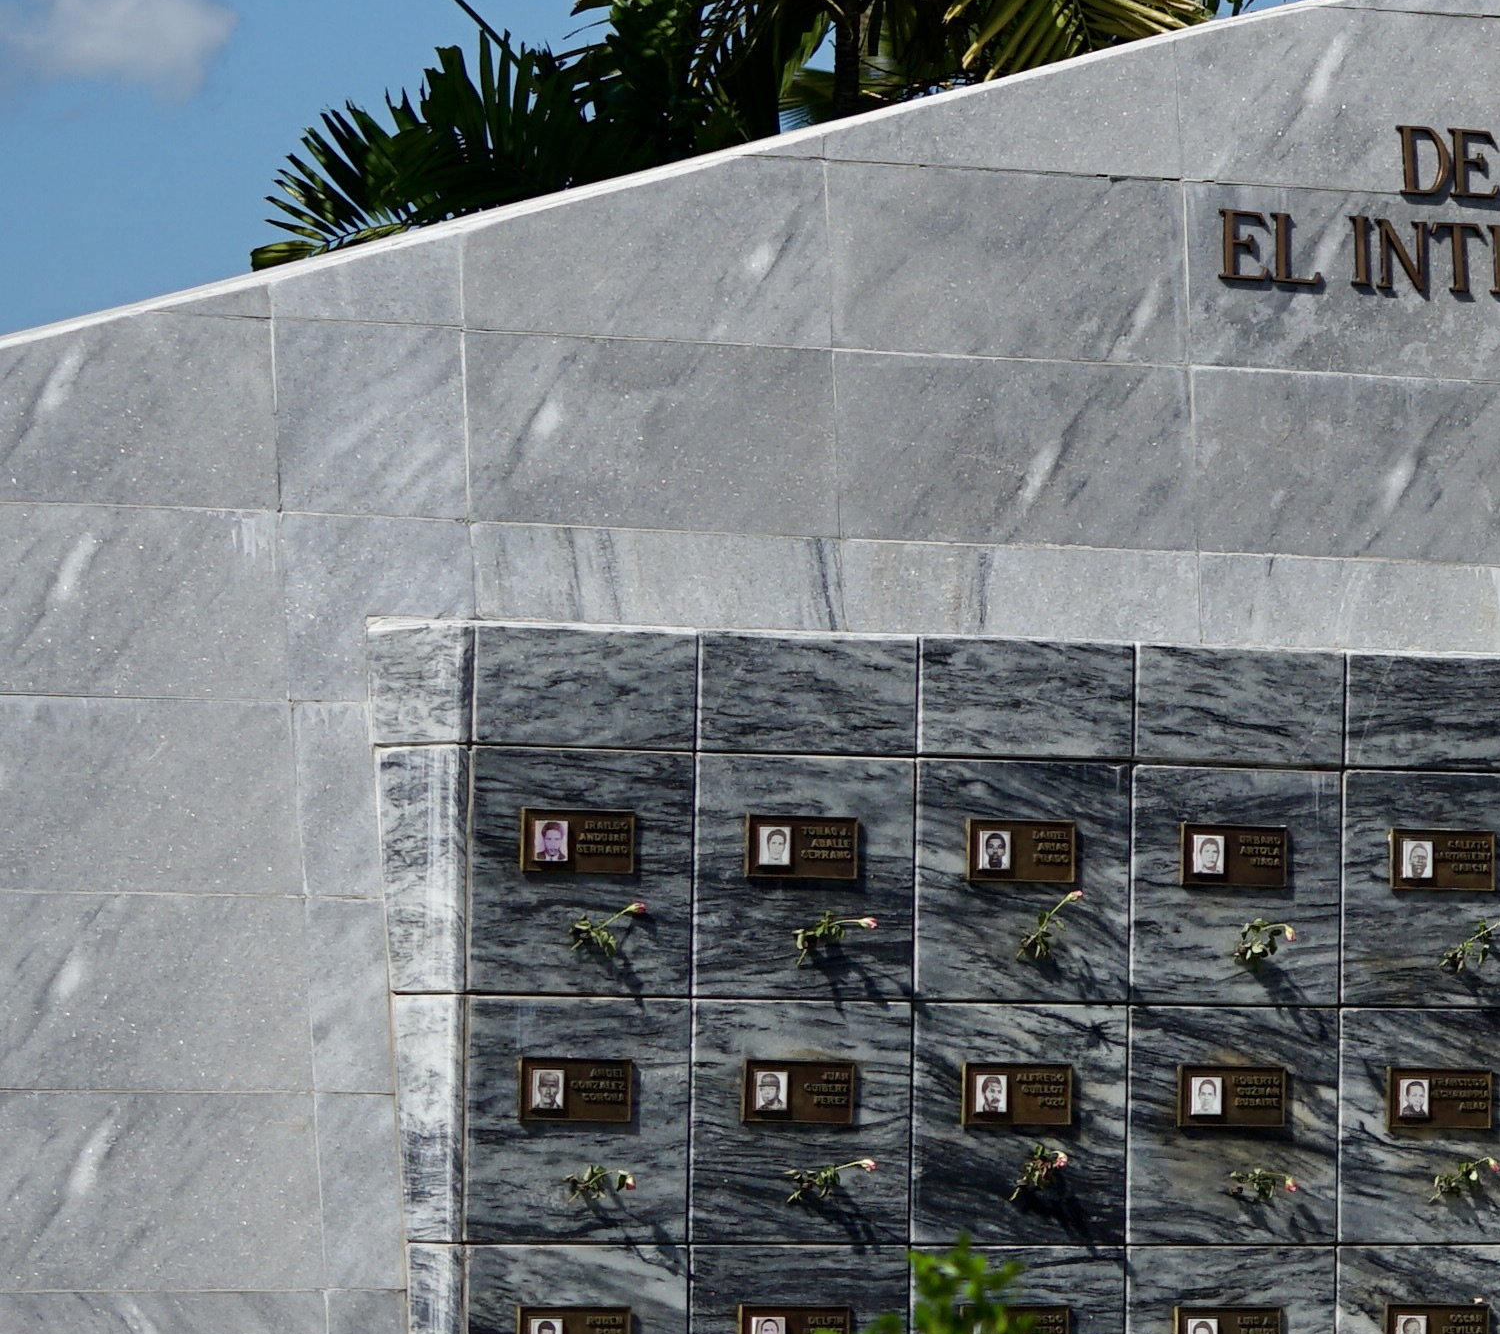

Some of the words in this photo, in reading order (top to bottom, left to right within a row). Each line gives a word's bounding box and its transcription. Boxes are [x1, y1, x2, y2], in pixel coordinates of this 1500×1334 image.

[1218, 207, 1323, 287] EL
[801, 849, 851, 859] SERRANO
[590, 1068, 625, 1077] ANGEL
[1016, 1073, 1065, 1082] ALFREDO
[570, 1080, 625, 1090] GONZALEZ
[813, 1095, 848, 1105] PEREZ
[1450, 1314, 1483, 1323] OSCAR
[1441, 1325, 1483, 1334] REVILLA
